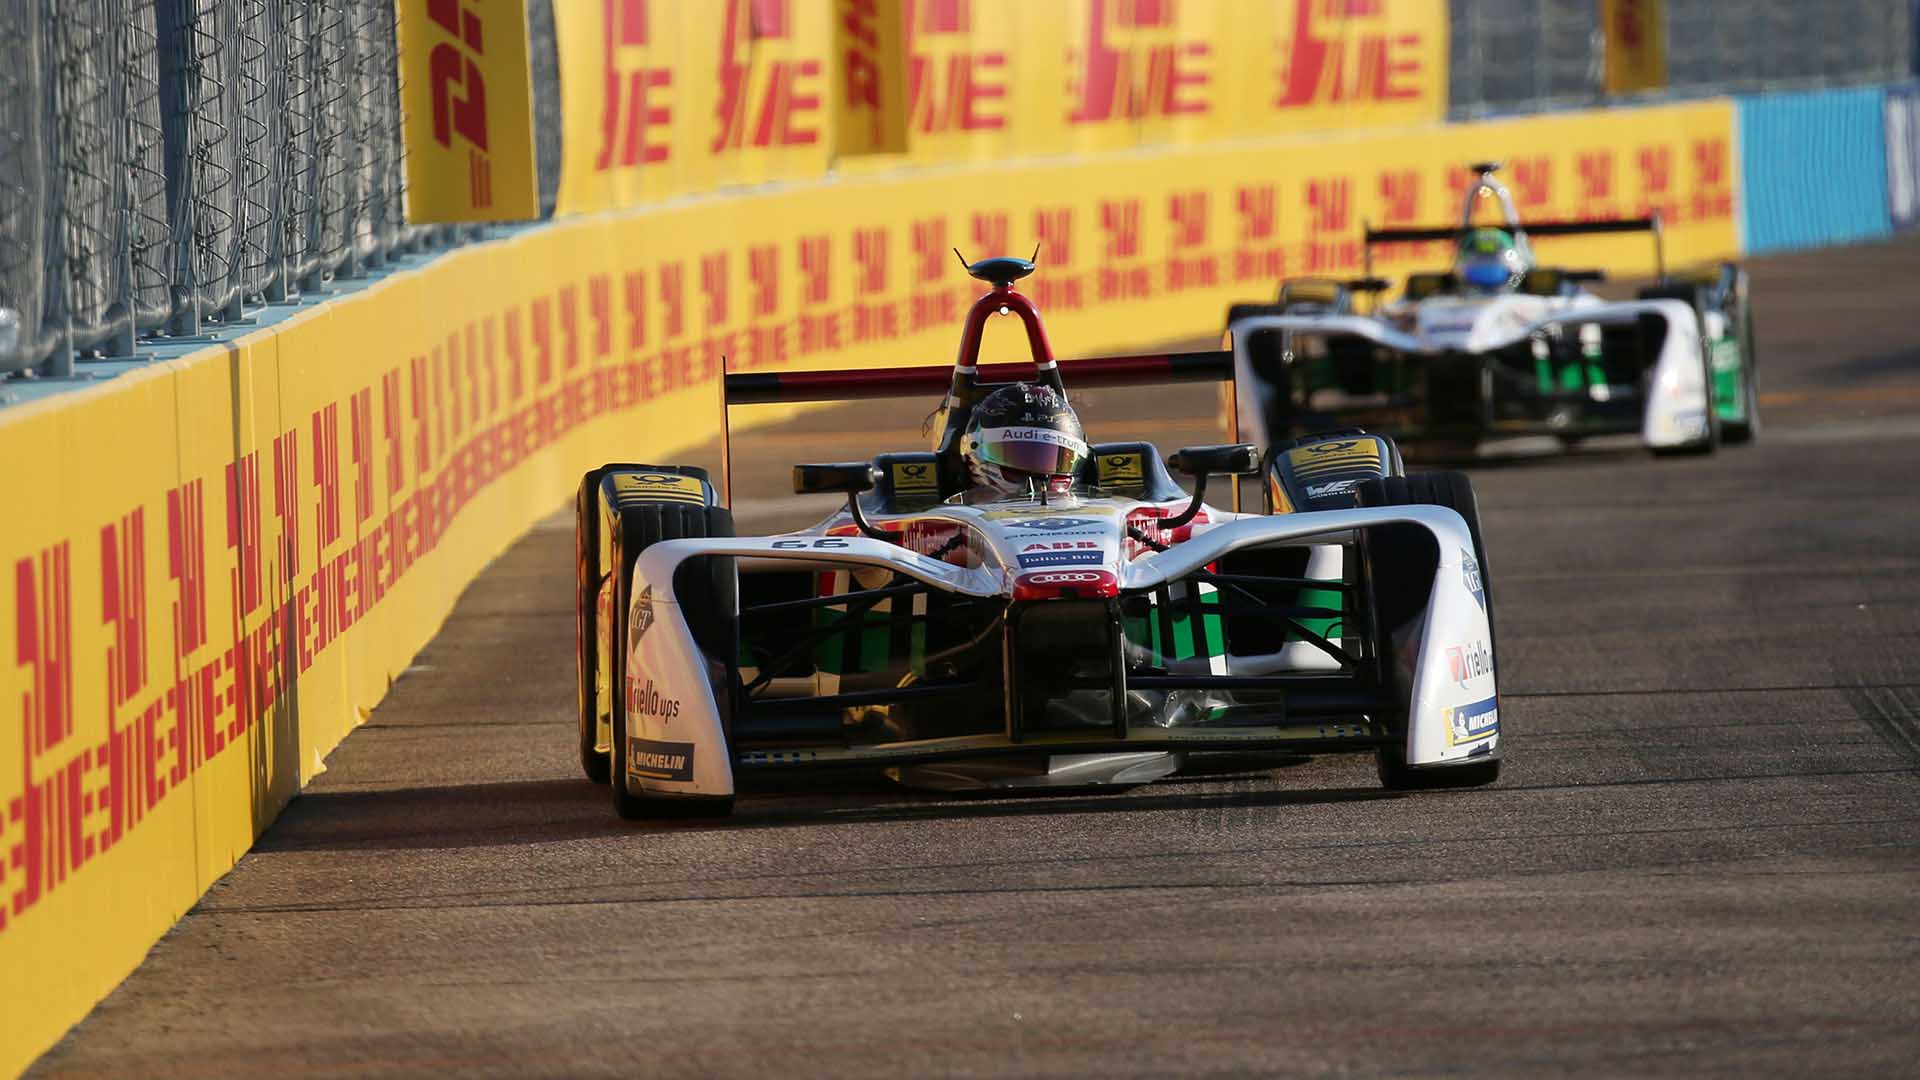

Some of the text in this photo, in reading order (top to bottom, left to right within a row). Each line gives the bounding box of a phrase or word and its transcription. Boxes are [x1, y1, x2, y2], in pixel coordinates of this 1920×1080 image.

[1002, 429, 1038, 440] Audi
[1023, 541, 1098, 552] ABB
[1466, 639, 1489, 679] riello
[632, 679, 680, 724] riello ups
[636, 751, 686, 770] MICHELIN
